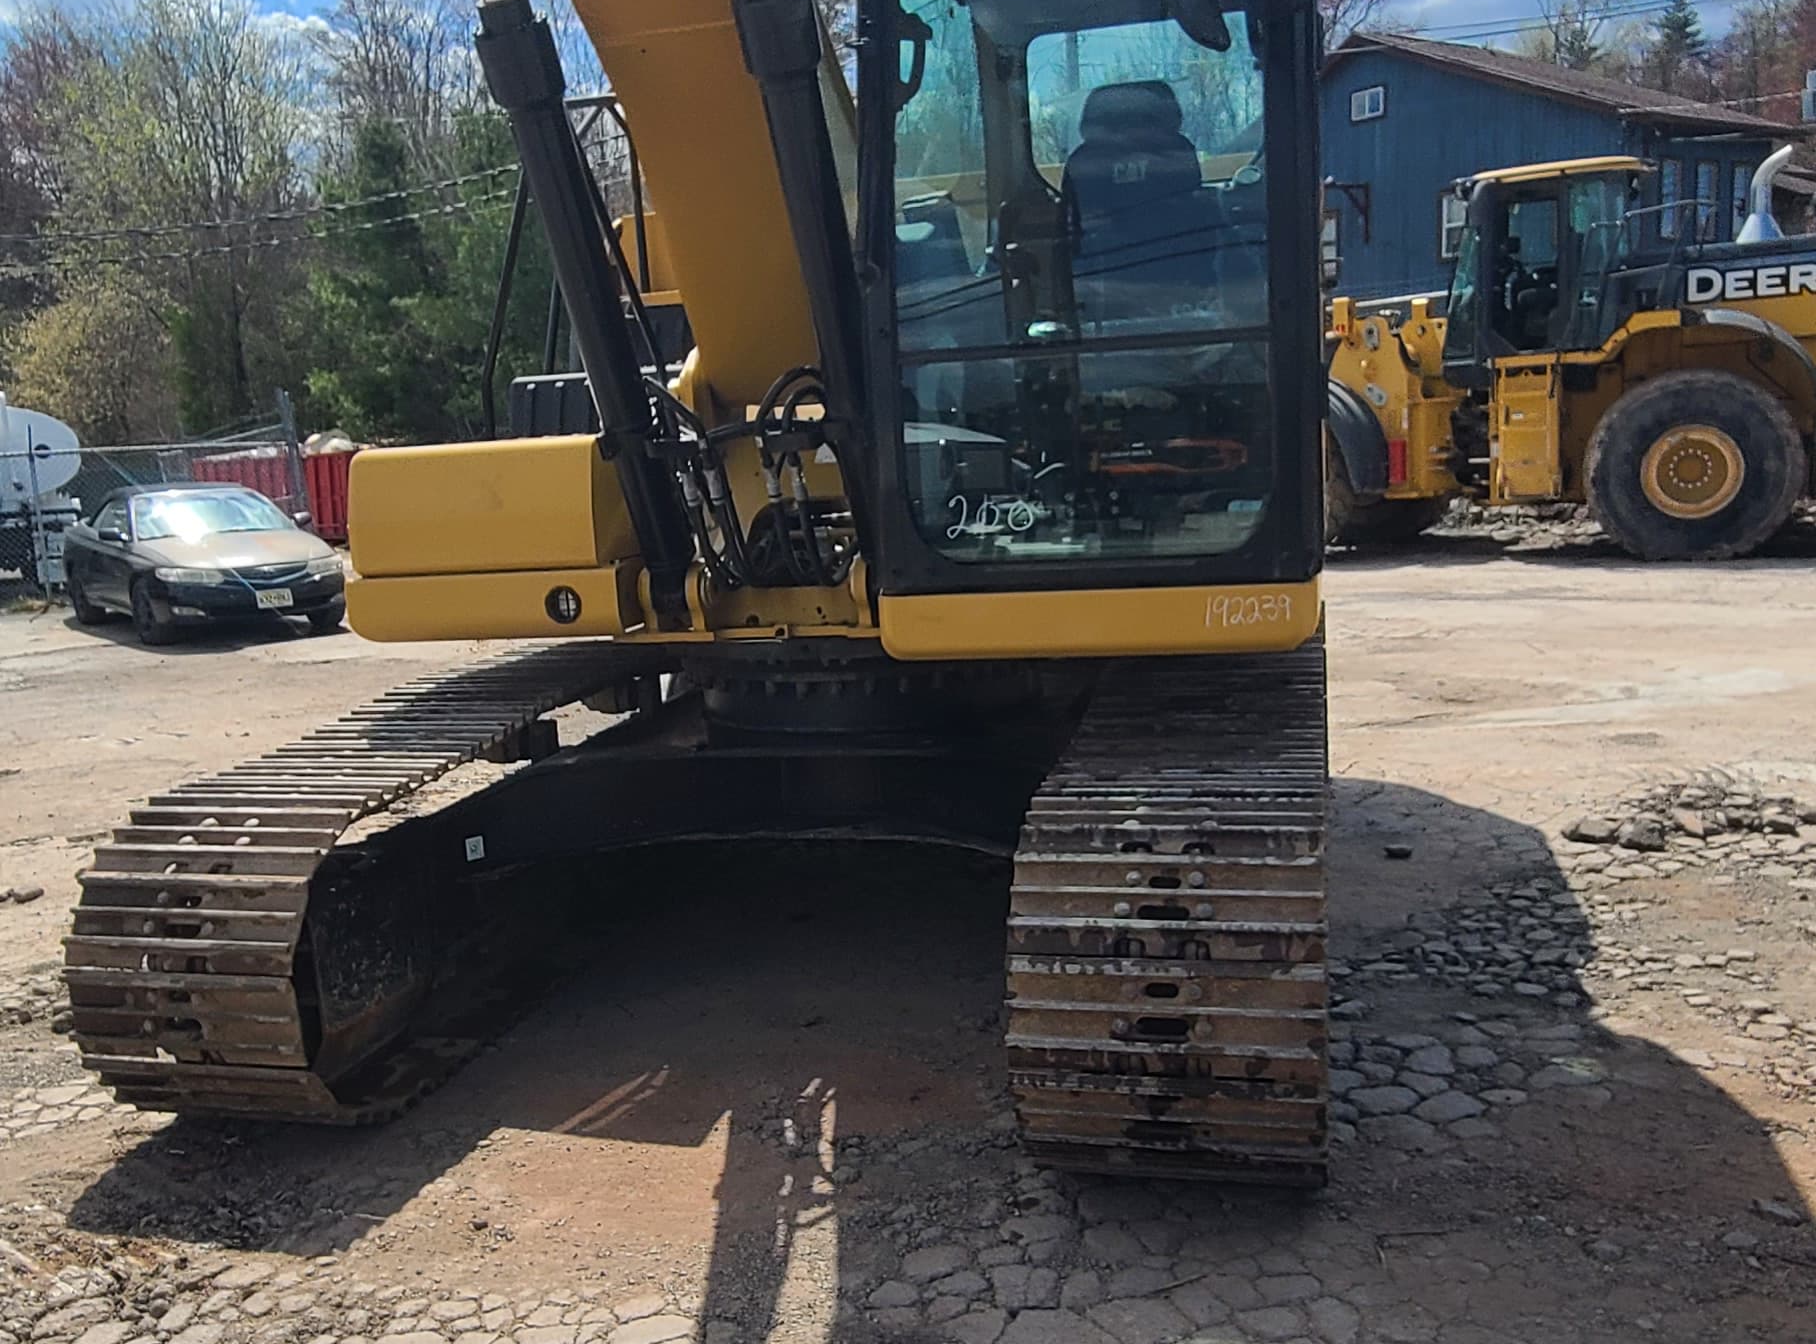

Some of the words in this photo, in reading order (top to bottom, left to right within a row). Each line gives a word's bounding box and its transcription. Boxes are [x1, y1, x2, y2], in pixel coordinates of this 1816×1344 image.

[1112, 160, 1149, 183] CAT
[1687, 263, 1816, 303] DEER
[1205, 593, 1290, 627] 192239
